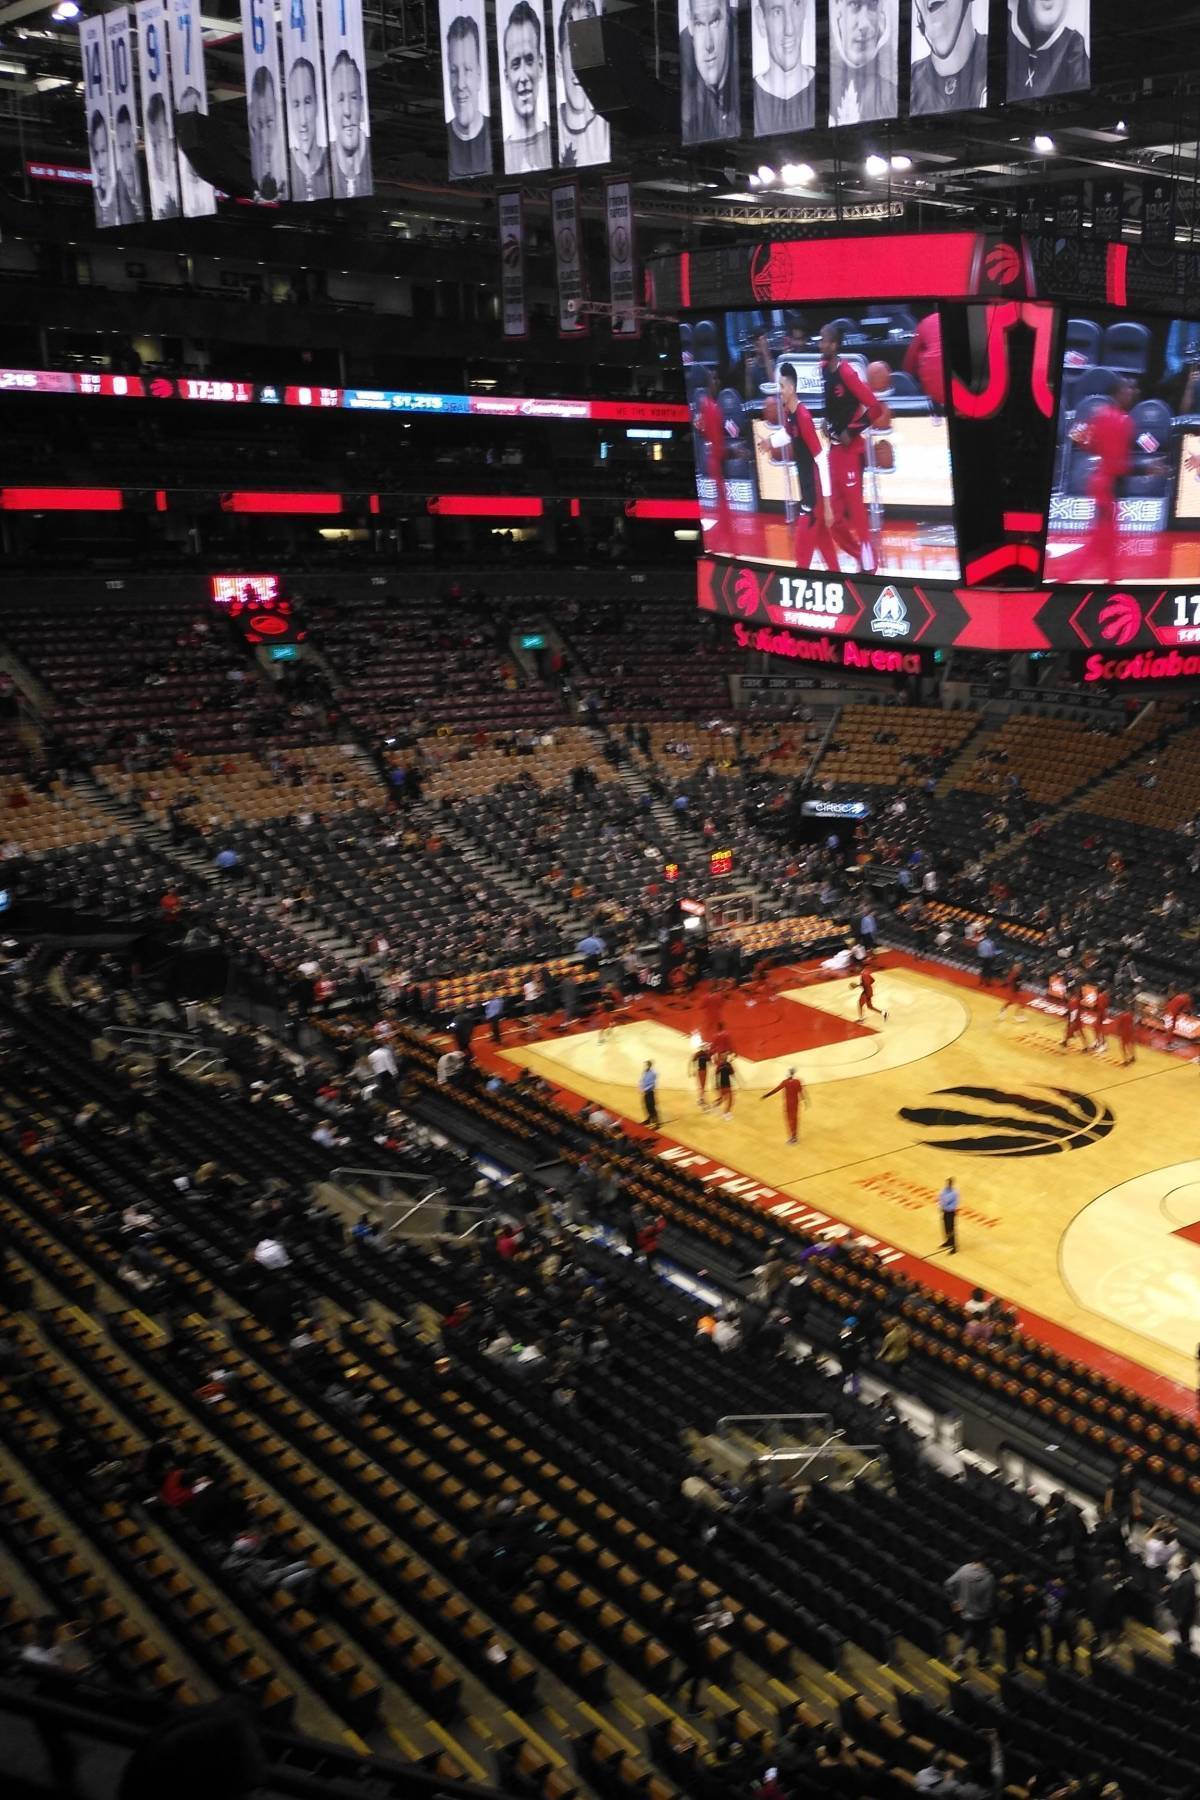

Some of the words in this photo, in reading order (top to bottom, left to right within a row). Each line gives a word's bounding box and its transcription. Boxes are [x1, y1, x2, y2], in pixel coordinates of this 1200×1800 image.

[177, 14, 193, 75] 7
[290, 0, 307, 42] 4
[84, 40, 103, 99] 14
[110, 37, 129, 94] 10
[146, 23, 161, 82] 9
[779, 576, 844, 614] 17:18
[733, 622, 840, 663] Scotiabank
[843, 640, 921, 674] Arena
